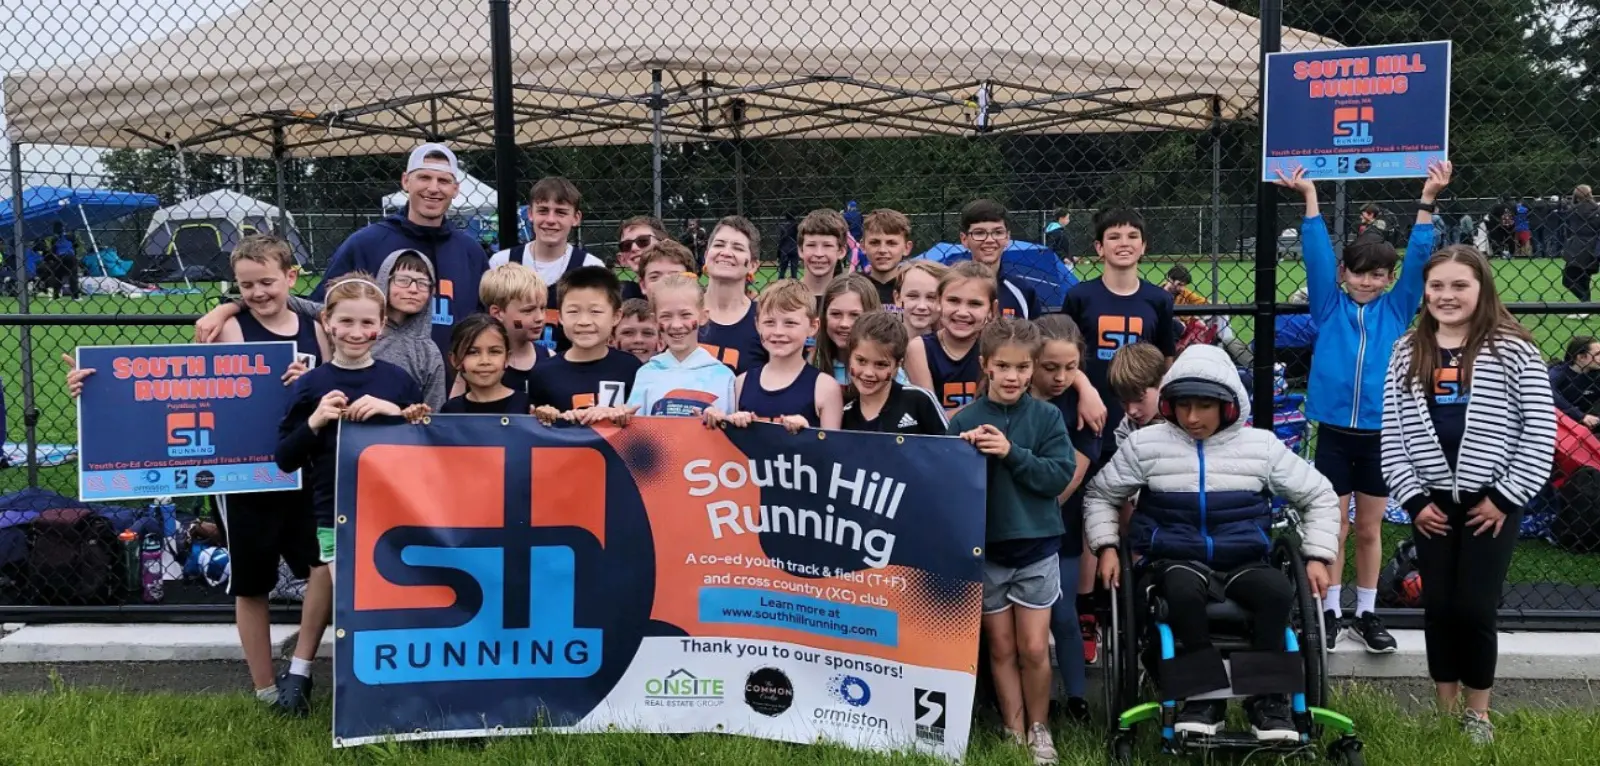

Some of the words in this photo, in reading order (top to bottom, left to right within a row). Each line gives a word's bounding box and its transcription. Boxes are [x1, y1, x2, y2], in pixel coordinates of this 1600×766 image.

[1294, 57, 1369, 80] SOUTH
[1376, 53, 1426, 75] HILL
[1310, 75, 1408, 98] RUNNING
[113, 355, 206, 380] SOUTH
[214, 354, 271, 376] HILL
[134, 377, 252, 401] RUNNING
[604, 384, 620, 408] 7
[88, 462, 113, 470] Youth
[115, 461, 140, 469] Co-Ed
[168, 458, 201, 467] Country
[203, 456, 218, 464] and
[220, 455, 241, 463] Track
[249, 454, 269, 462] Field
[683, 454, 818, 497] South
[828, 462, 906, 519] Hill
[706, 499, 896, 569] Running
[685, 553, 697, 565] A
[700, 553, 742, 566] co-ed
[744, 555, 785, 570] youth
[787, 559, 820, 577] track
[822, 565, 831, 577] &
[834, 566, 864, 582] field
[866, 572, 908, 592] (T+F)
[703, 572, 731, 585] and
[733, 577, 770, 589] cross
[773, 579, 823, 599] country
[825, 585, 856, 604] (XC)
[859, 591, 888, 607] club
[760, 597, 794, 611] Learn
[799, 603, 826, 616] more
[828, 607, 841, 619] at
[722, 608, 877, 637] www.southhillrunning.com
[681, 639, 732, 654] Thank
[736, 644, 768, 657] you
[772, 645, 790, 659] to
[794, 649, 820, 664] our
[824, 656, 903, 679] sponsors!
[645, 679, 724, 695] ONSITE
[745, 684, 793, 696] COMMON
[813, 708, 888, 729] ormiston
